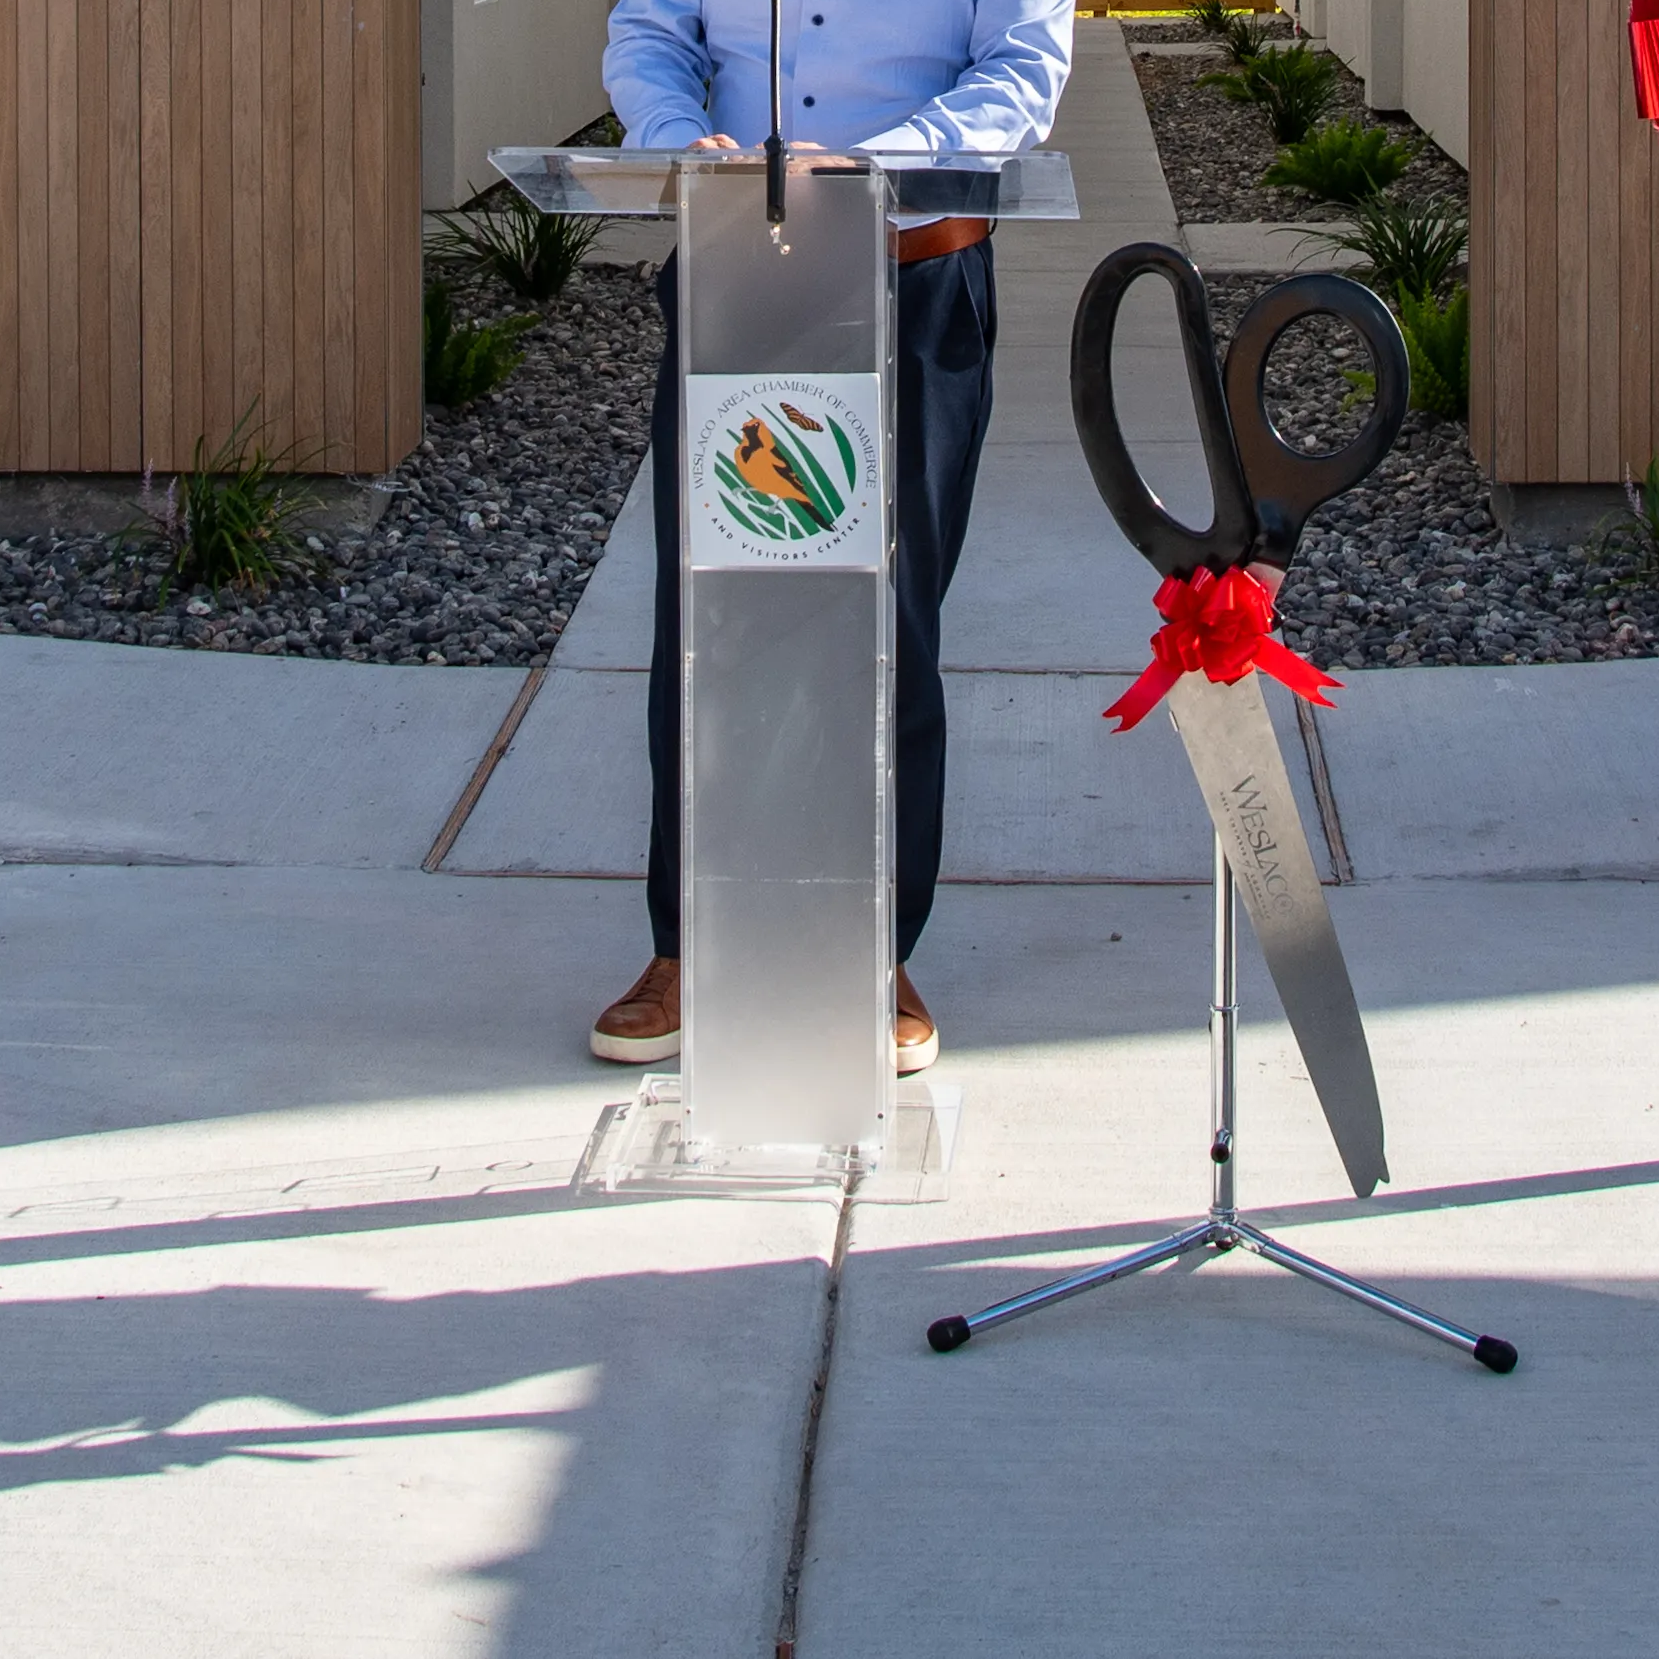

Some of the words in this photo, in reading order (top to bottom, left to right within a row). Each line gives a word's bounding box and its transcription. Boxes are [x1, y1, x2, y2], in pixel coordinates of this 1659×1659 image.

[692, 419, 718, 490] WESLACO
[716, 390, 752, 419] AREA
[752, 379, 825, 400] CHAMBER
[826, 394, 847, 411] OF
[844, 410, 878, 489] COMMERCE
[711, 517, 734, 541] AND
[740, 541, 809, 562] VISITORS
[817, 517, 861, 555] CENTER
[1231, 774, 1293, 913] WESLACO
